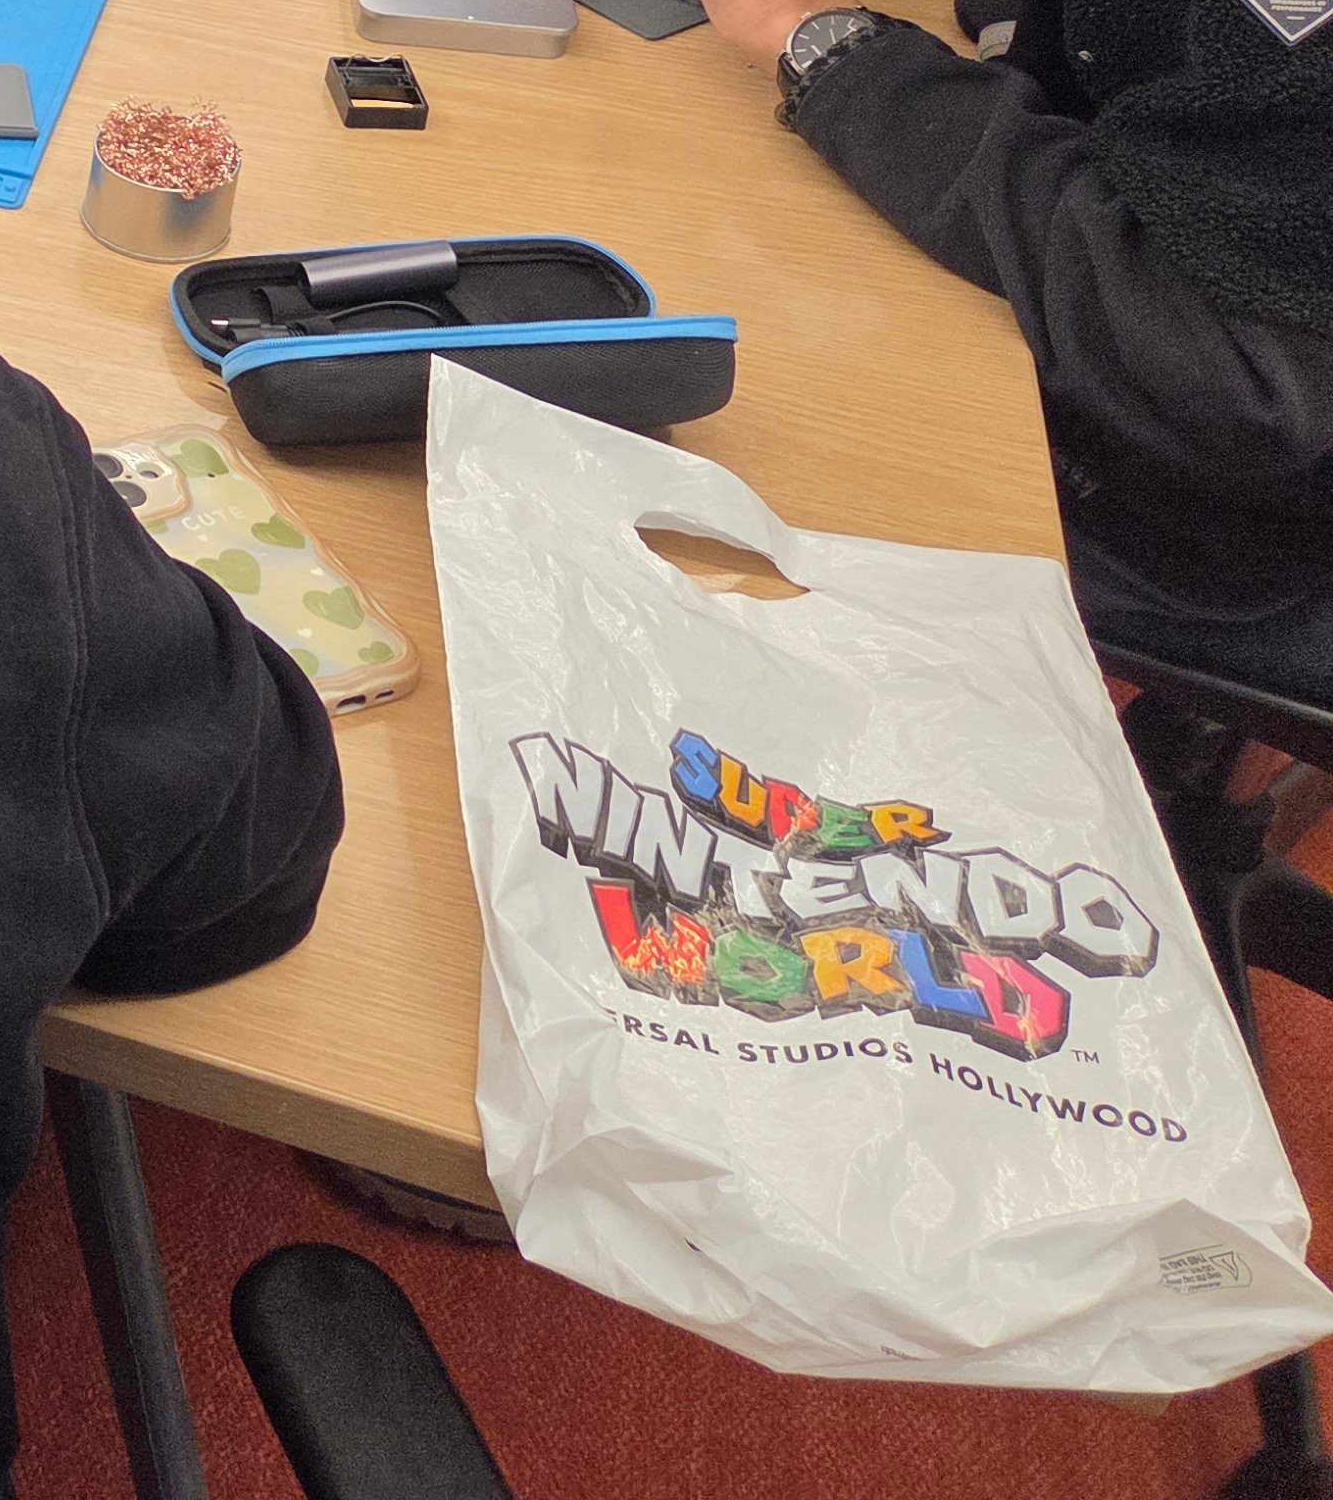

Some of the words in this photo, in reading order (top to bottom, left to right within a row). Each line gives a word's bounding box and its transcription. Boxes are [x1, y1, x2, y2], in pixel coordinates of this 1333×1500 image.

[180, 505, 247, 531] CUTE
[508, 732, 1160, 977] NINTENDO
[670, 728, 951, 858] SUPER
[586, 876, 1071, 1062] WORLD
[603, 1007, 719, 1056] RSAL
[737, 1036, 913, 1065] STUDIOS
[931, 1053, 1188, 1144] HOLLYWOOD
